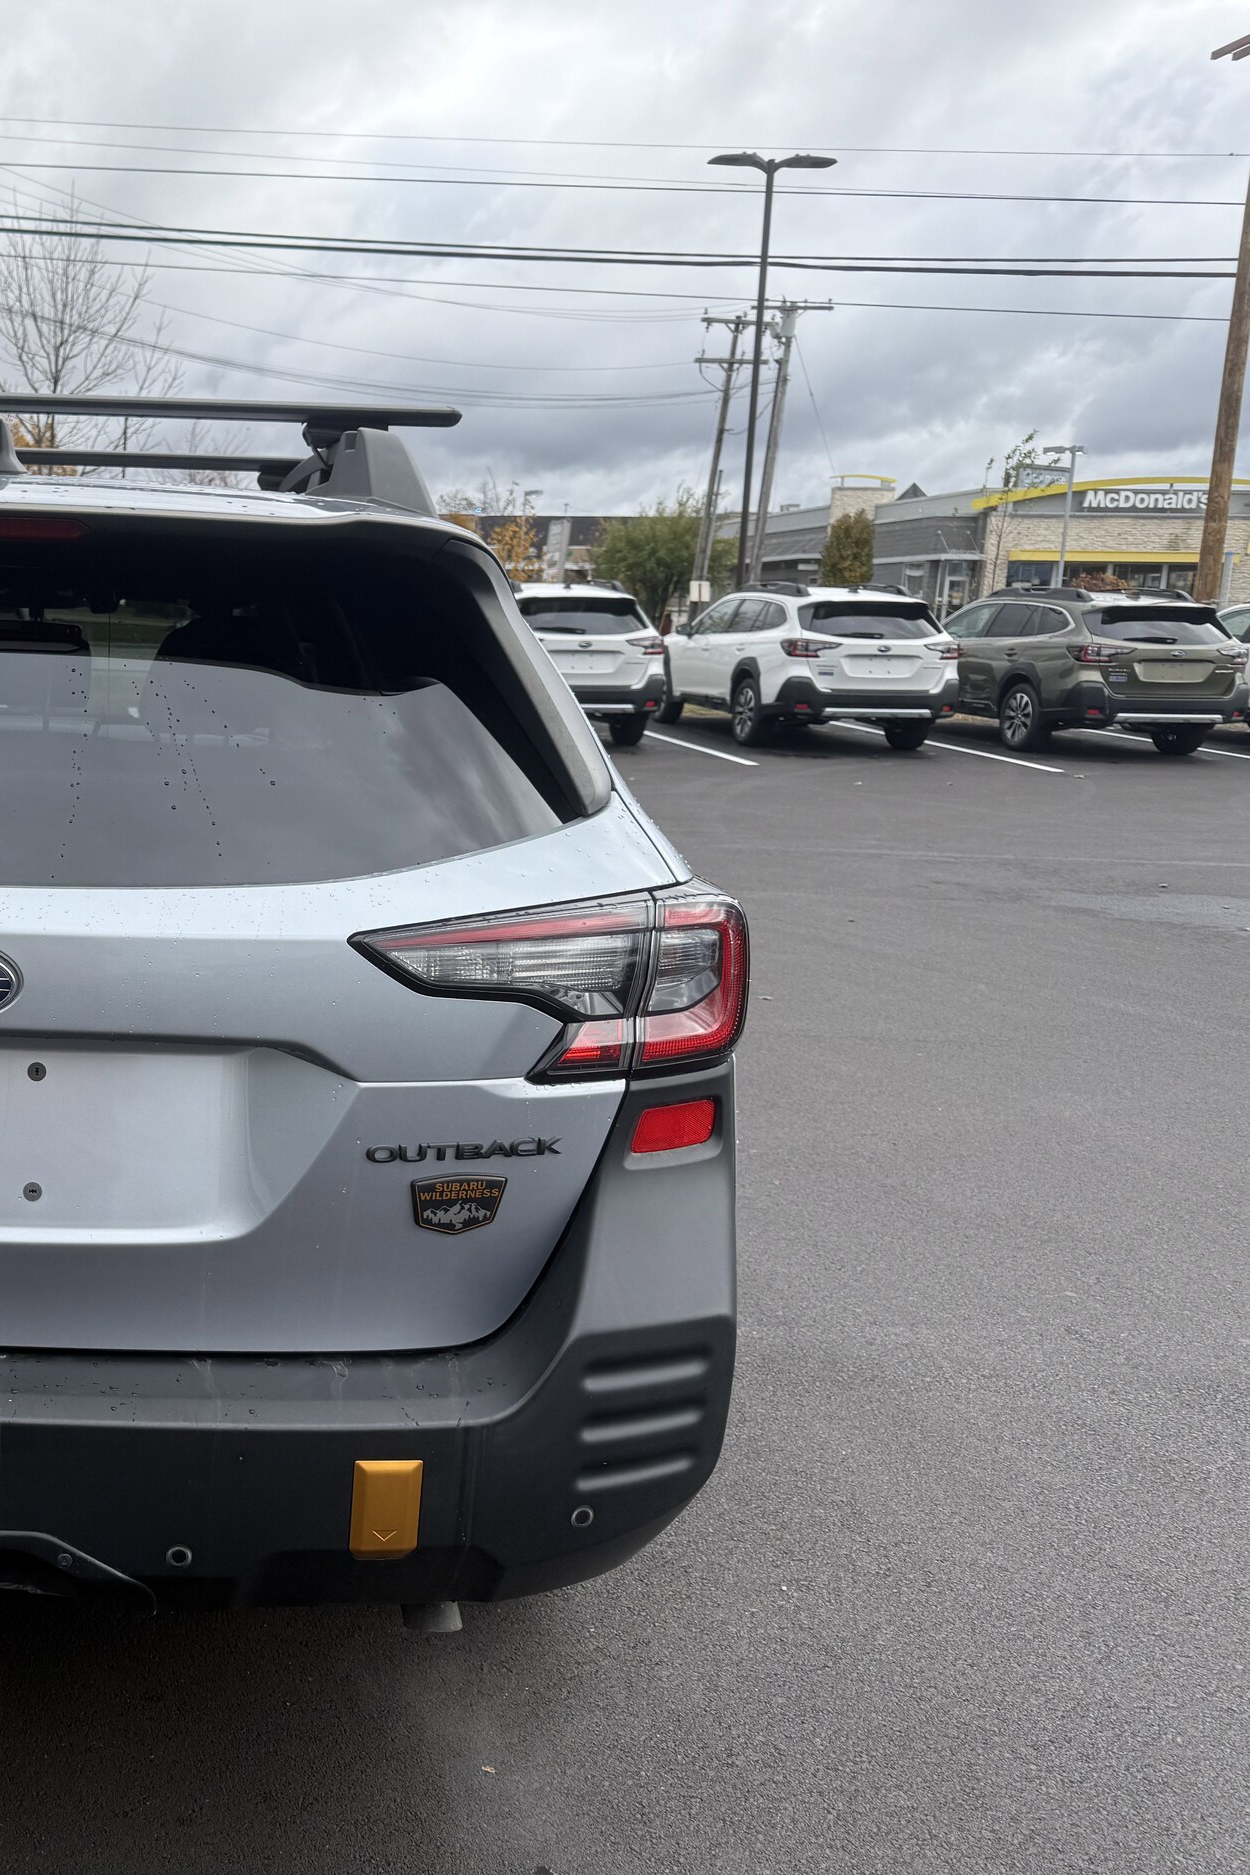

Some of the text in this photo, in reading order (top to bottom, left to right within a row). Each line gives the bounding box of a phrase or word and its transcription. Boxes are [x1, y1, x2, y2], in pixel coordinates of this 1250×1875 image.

[1082, 489, 1209, 509] McDonald's
[365, 1136, 563, 1164] OUTBACK
[435, 1180, 487, 1192] SUBARU
[419, 1188, 500, 1201] WILDERNESS
